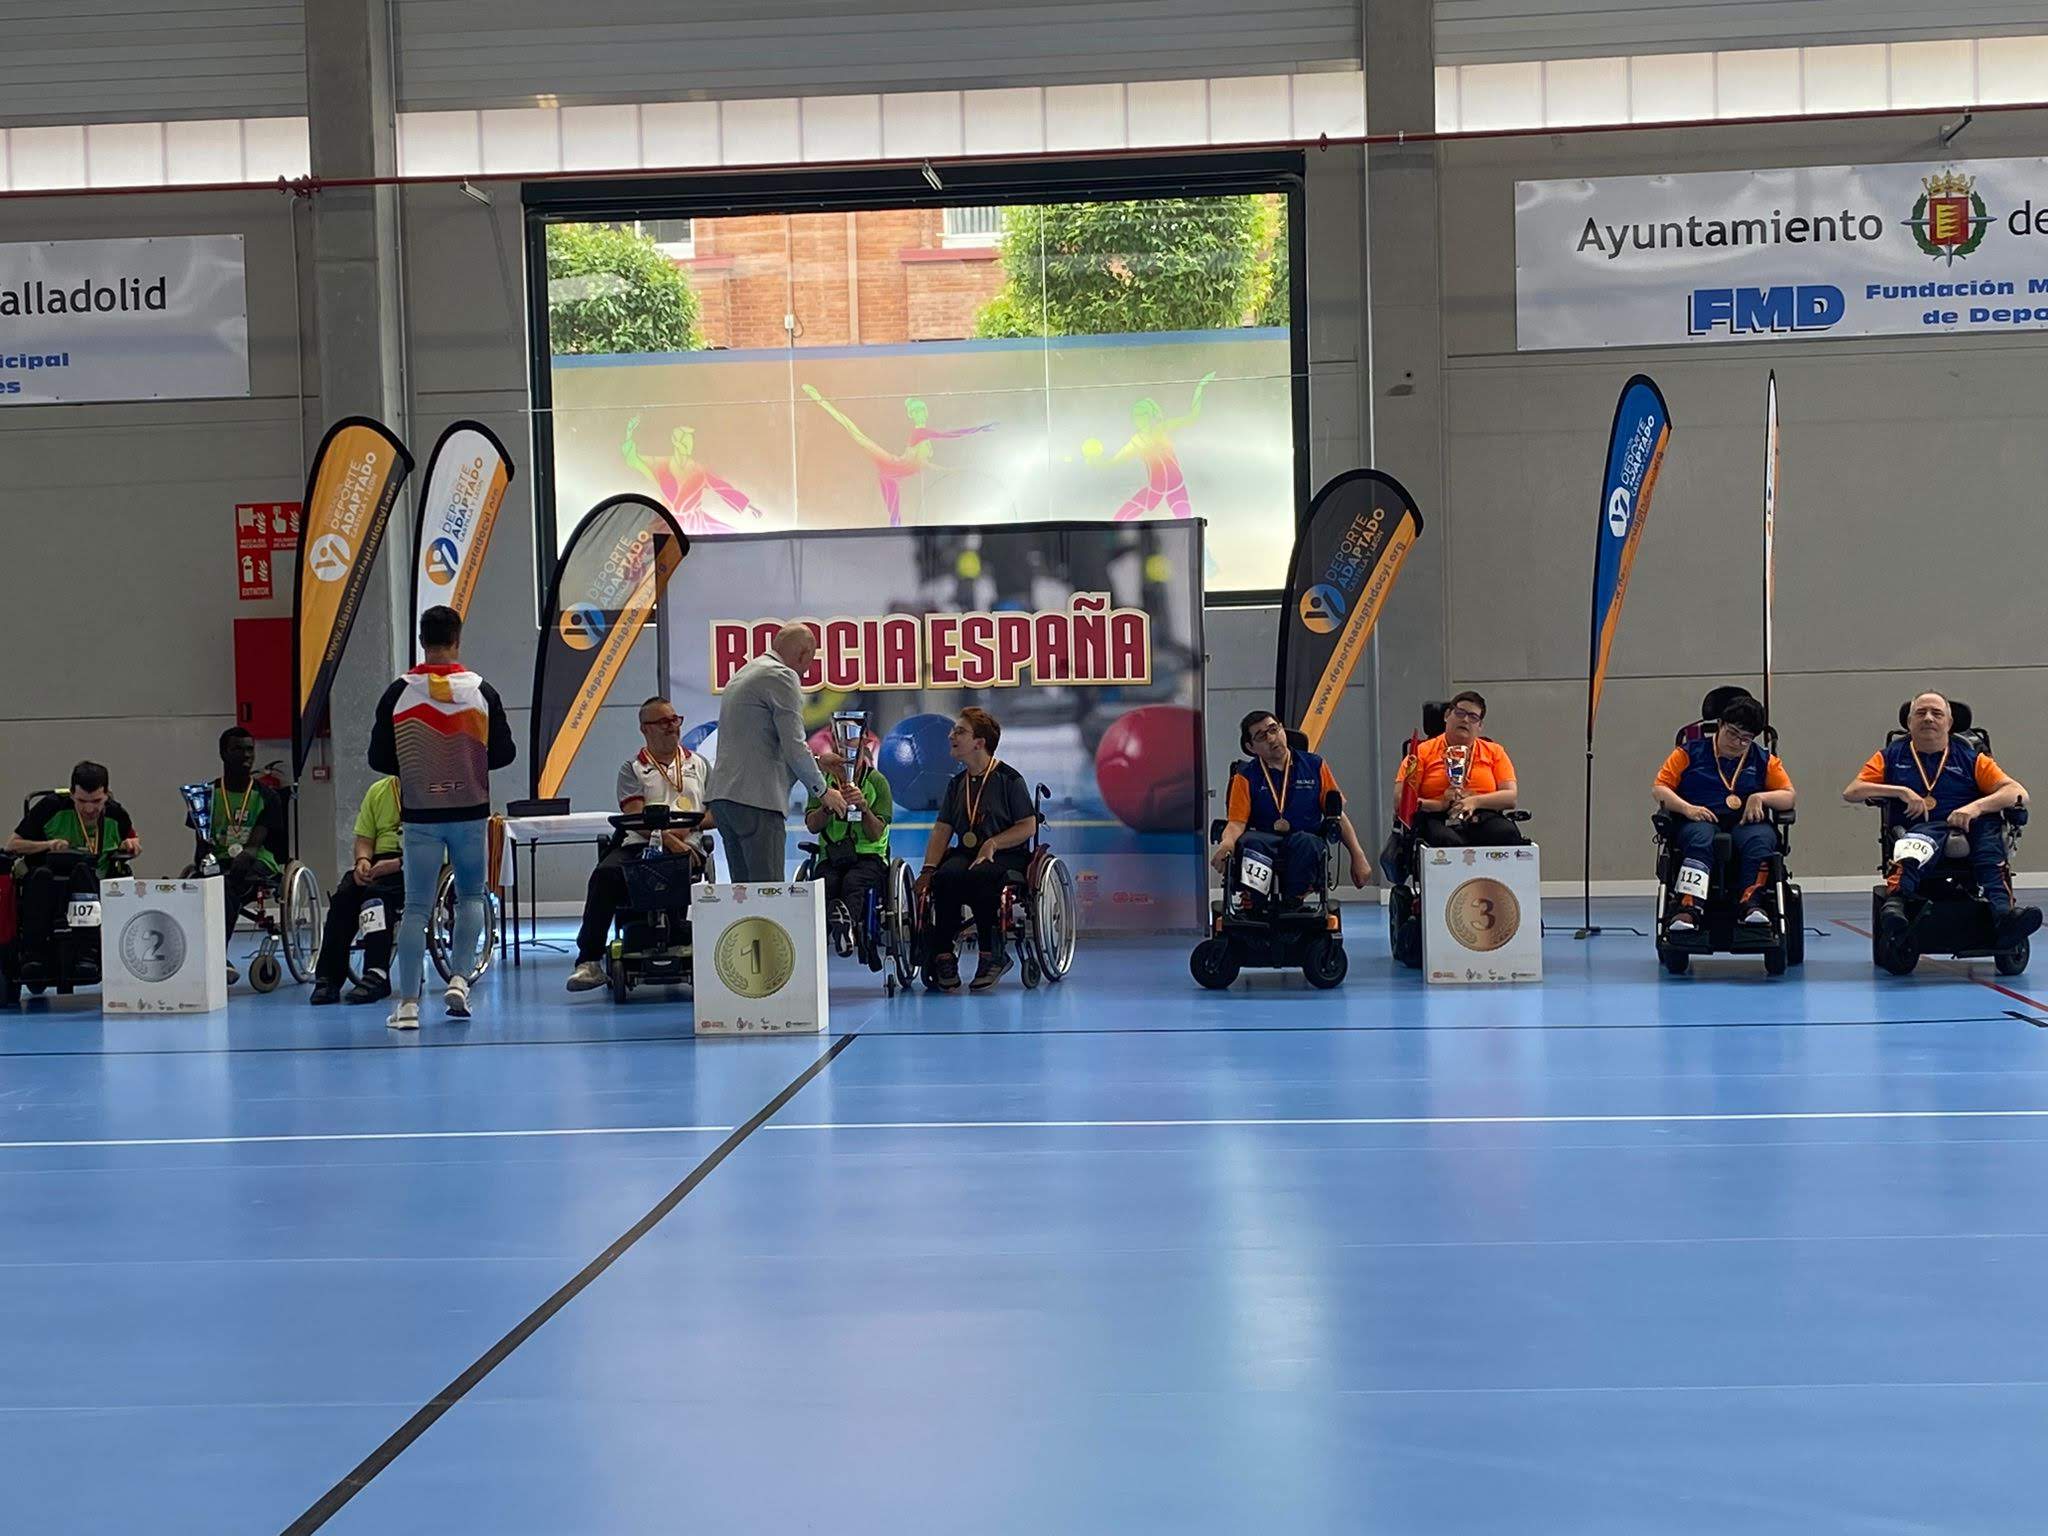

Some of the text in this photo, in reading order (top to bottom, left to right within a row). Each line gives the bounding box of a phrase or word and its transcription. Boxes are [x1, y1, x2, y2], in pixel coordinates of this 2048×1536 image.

[1577, 209, 1883, 259] Ayuntamiento
[1688, 285, 1845, 335] FMD
[1866, 280, 2014, 299] Fundación
[1922, 309, 1958, 324] de
[1630, 415, 1655, 487] DAPTADO
[331, 460, 361, 530] DEPORTE
[341, 452, 376, 535] ADAPTADO
[442, 463, 471, 534] DEPORTE
[452, 457, 483, 540] ADAPTADO
[590, 535, 631, 600] DEPORTE
[601, 531, 650, 608] ADAPTADO
[1325, 513, 1368, 580] DEPORTE
[1338, 508, 1385, 588] ADAPTADO
[927, 594, 1149, 687] ESPAÑA
[430, 782, 464, 793] ESP
[1246, 863, 1268, 882] 113
[1903, 841, 1928, 855] 206
[1680, 870, 1702, 886] 112
[73, 904, 93, 916] 107
[1470, 898, 1496, 931] 3
[142, 930, 166, 962] 2
[740, 939, 760, 975] 1
